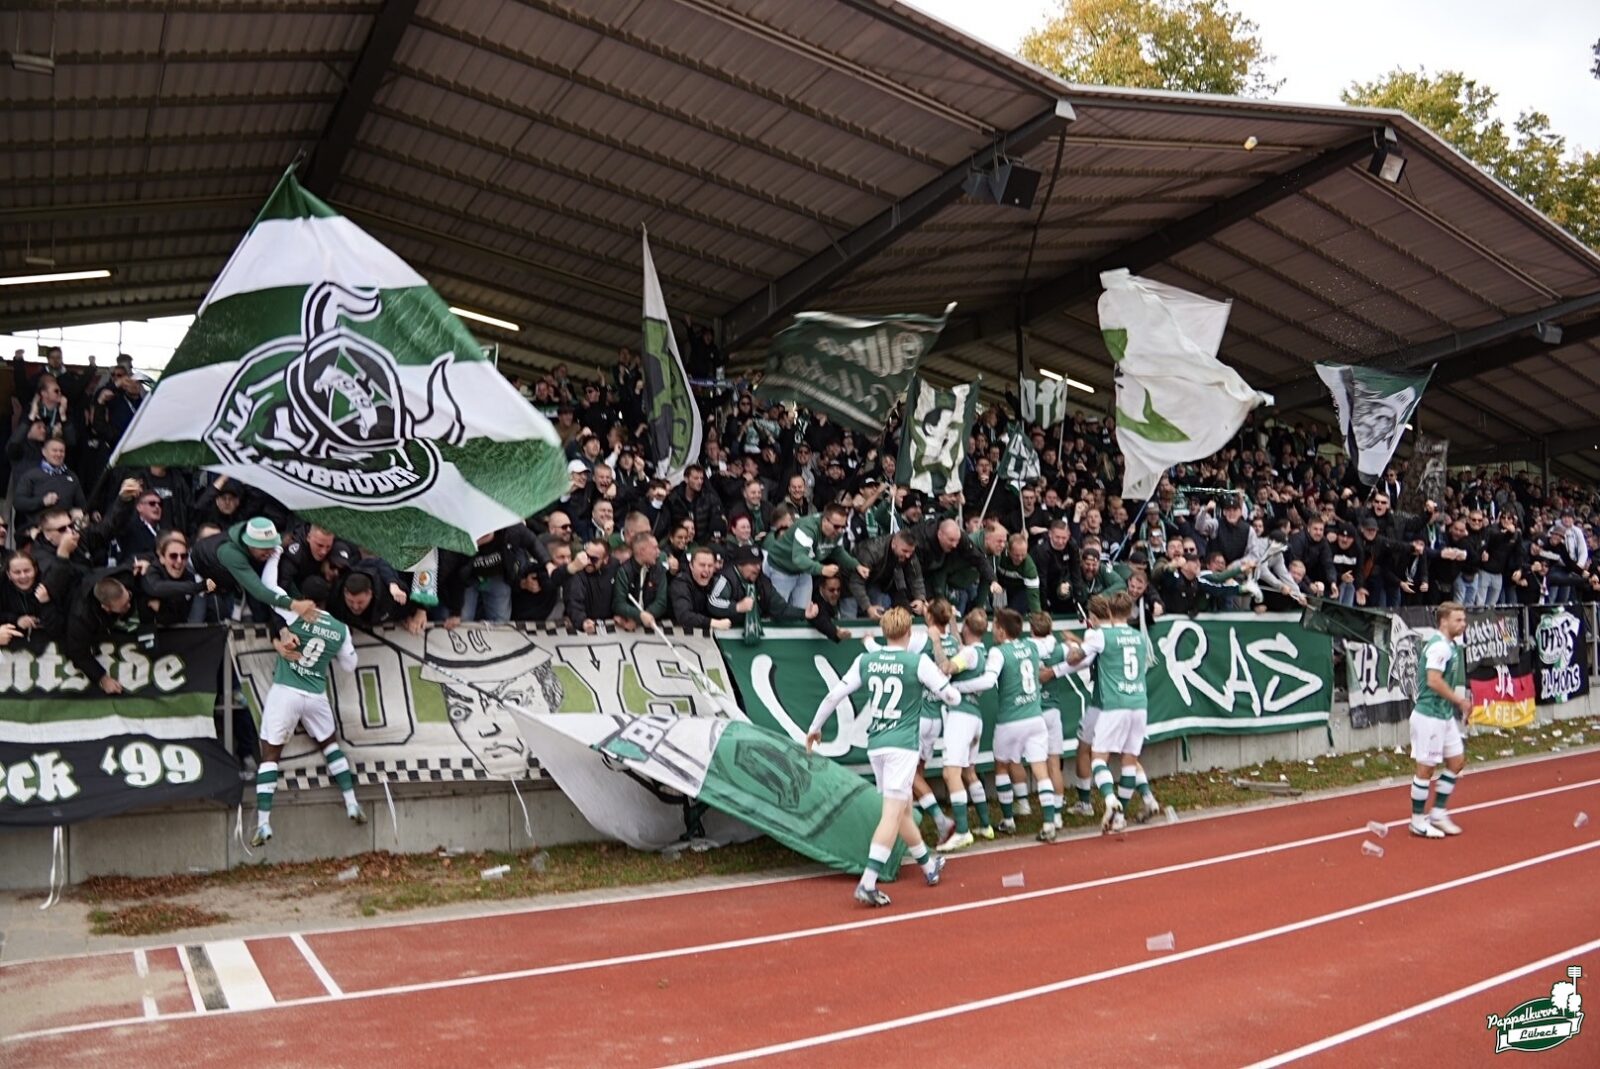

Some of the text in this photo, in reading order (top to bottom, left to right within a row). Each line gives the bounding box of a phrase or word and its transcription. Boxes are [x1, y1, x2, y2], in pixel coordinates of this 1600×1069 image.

[298, 637, 326, 668] 9
[868, 662, 904, 674] SOMMER
[1123, 646, 1138, 681] 5
[1020, 659, 1037, 694] 8
[868, 675, 903, 719] 22
[0, 751, 81, 802] ck
